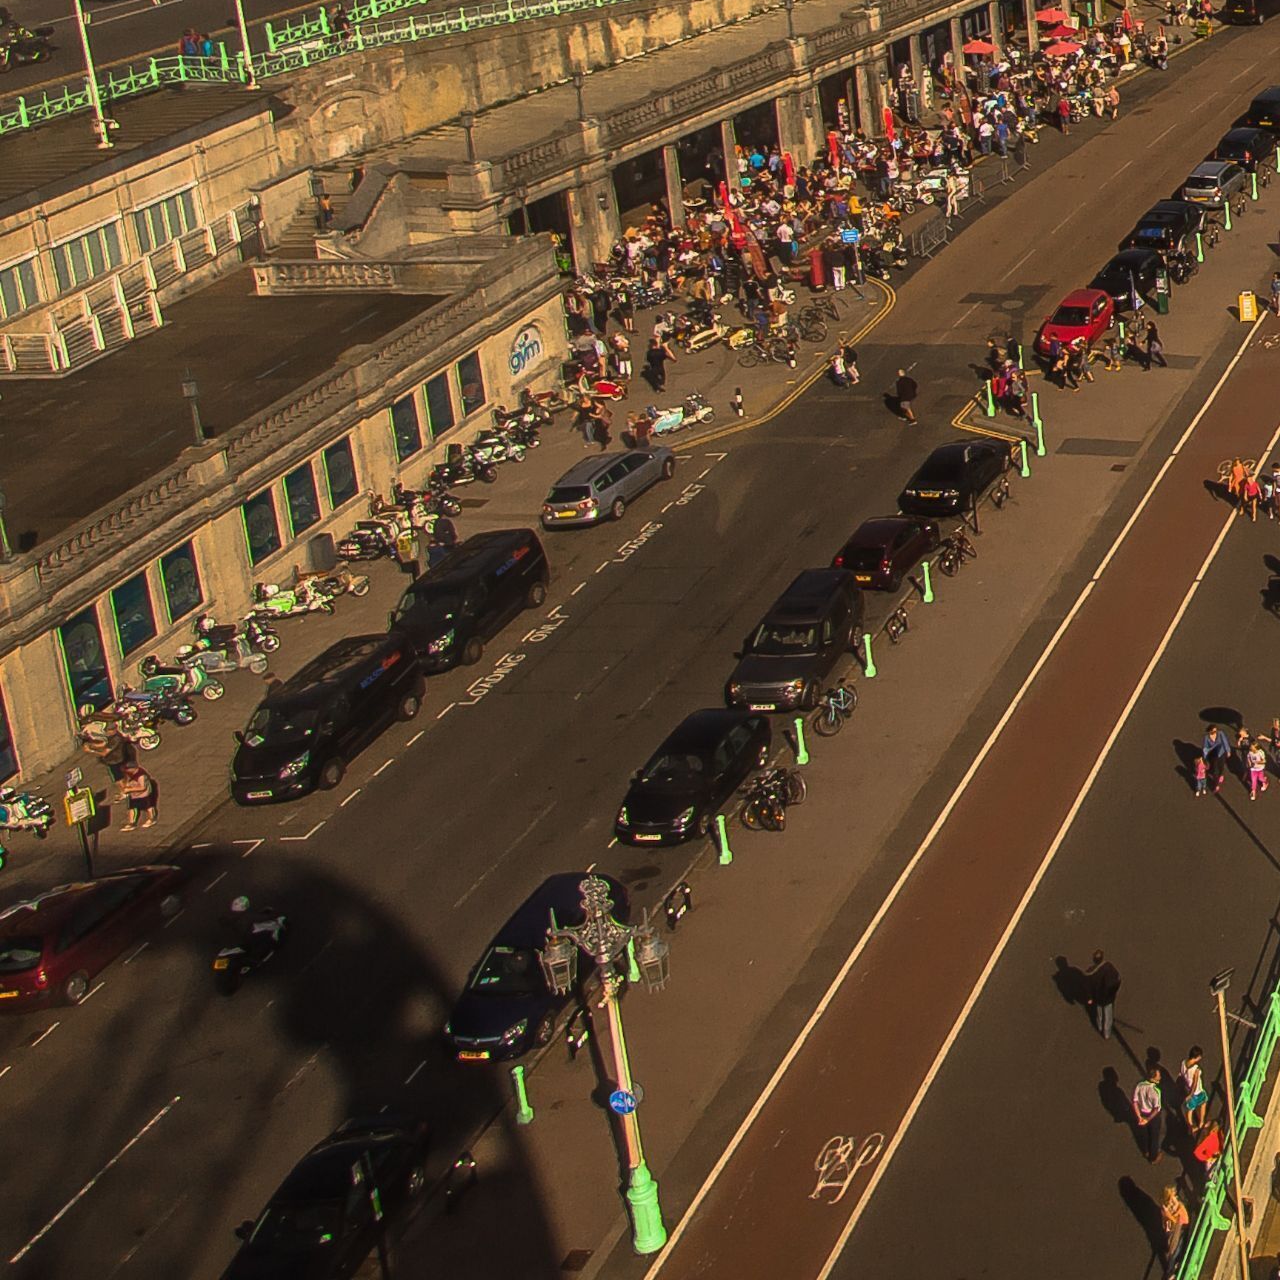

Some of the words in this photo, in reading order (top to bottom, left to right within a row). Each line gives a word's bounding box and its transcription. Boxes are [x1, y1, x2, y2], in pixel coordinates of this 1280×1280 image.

[510, 340, 541, 376] gym
[612, 523, 664, 562] LOADING
[676, 484, 706, 505] ONLY
[457, 652, 527, 706] LOADING
[529, 611, 571, 643] ONLY
